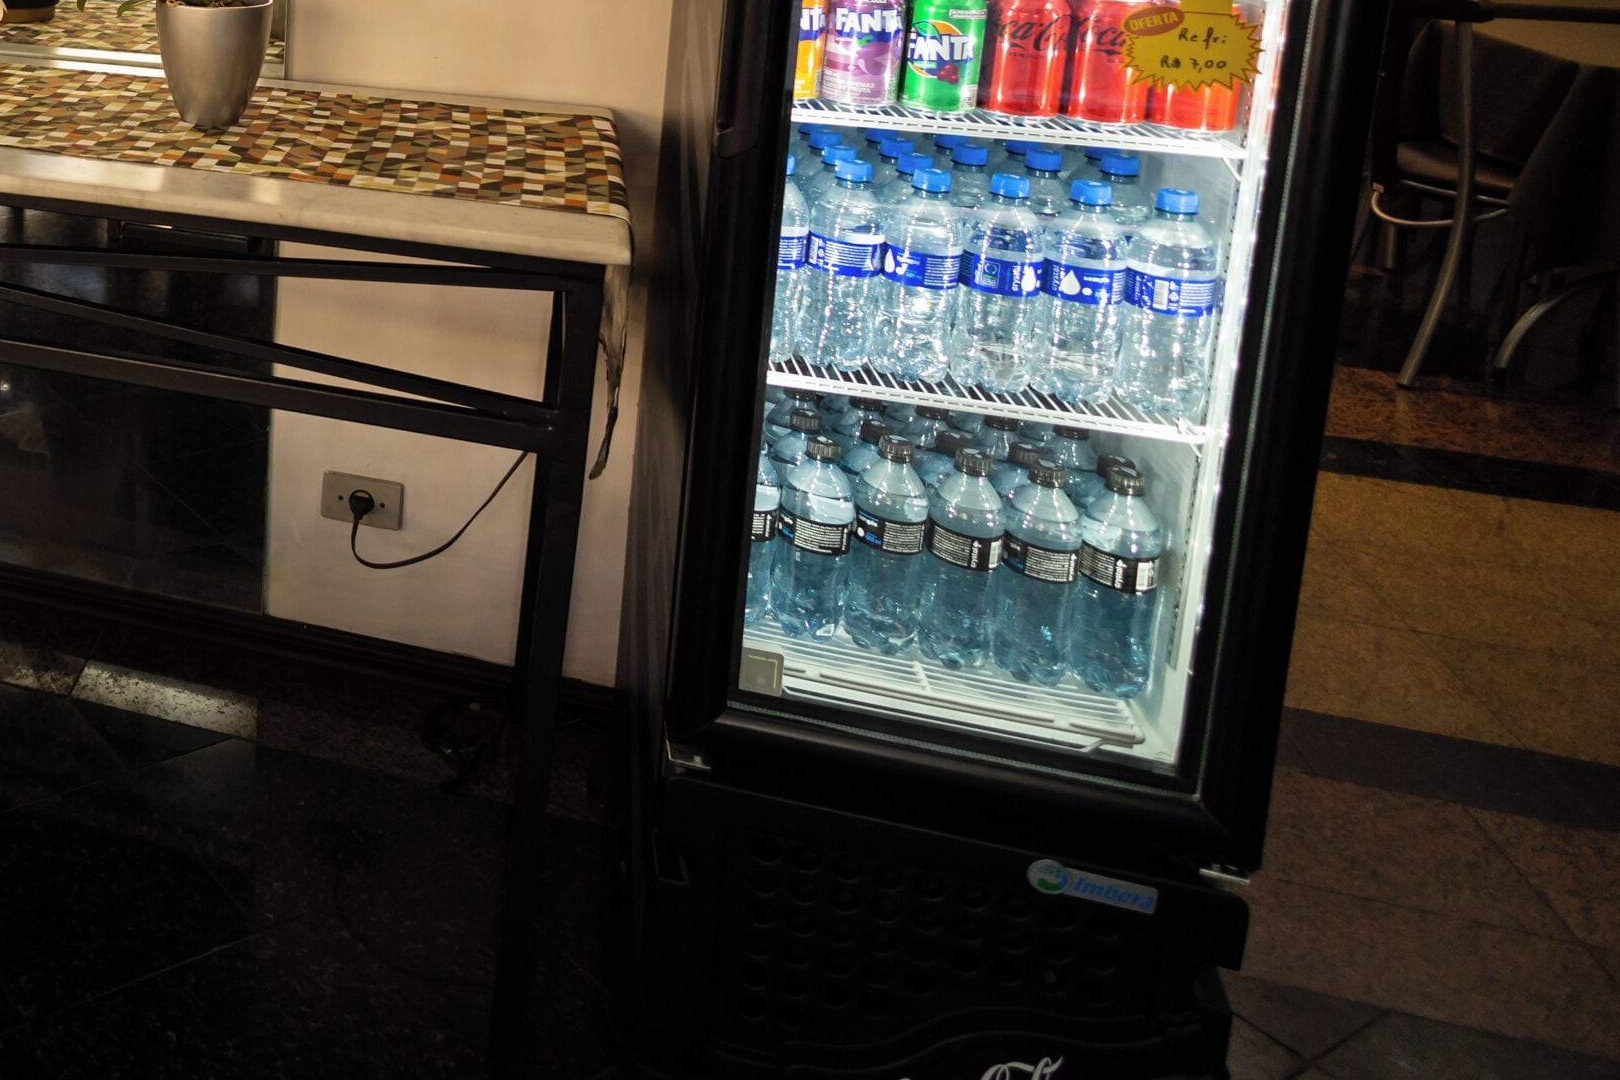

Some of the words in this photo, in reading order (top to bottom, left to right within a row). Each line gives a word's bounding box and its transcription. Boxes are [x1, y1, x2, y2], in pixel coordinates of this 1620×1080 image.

[1130, 10, 1180, 32] OFERTA
[1189, 57, 1228, 73] 7,00
[1072, 876, 1156, 910] Imbera
